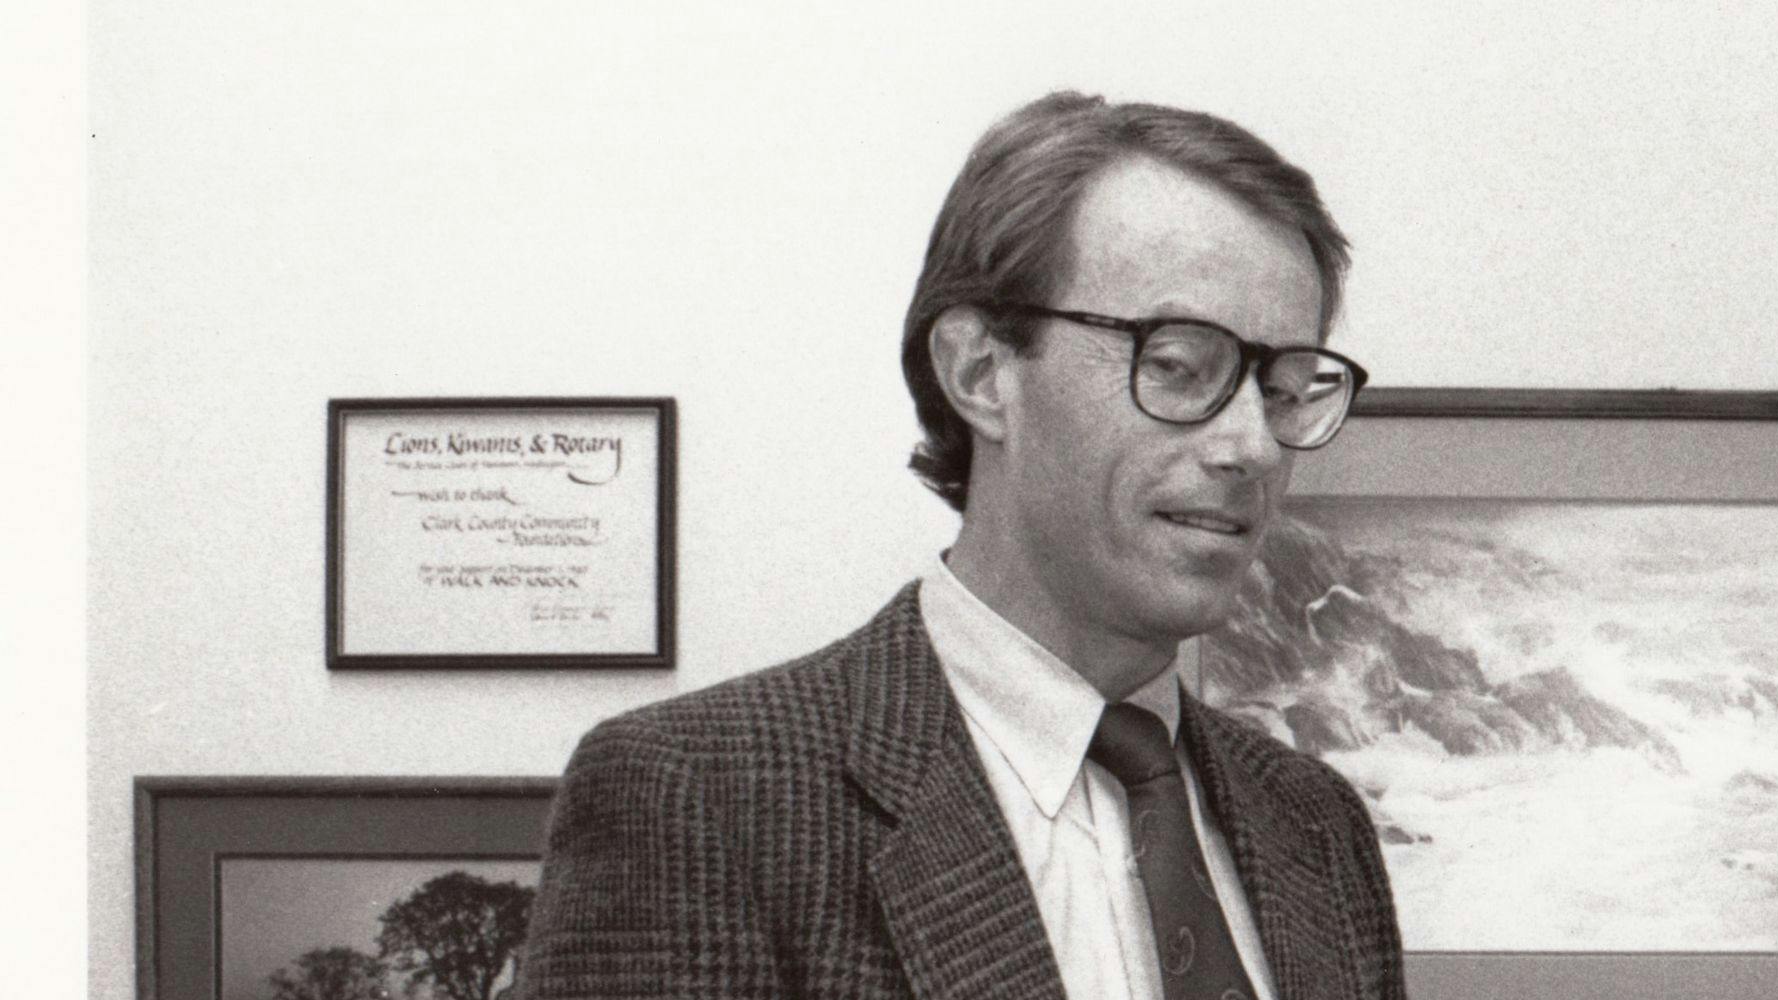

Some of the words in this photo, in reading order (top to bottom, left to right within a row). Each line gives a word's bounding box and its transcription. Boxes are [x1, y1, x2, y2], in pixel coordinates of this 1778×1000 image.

[384, 432, 442, 455] Lions,
[447, 432, 525, 457] Kiwanis,
[529, 433, 547, 454] &
[453, 489, 467, 501] to
[470, 486, 516, 505] thank
[421, 515, 464, 532] Clark
[468, 514, 517, 532] County
[519, 513, 600, 534] Community
[440, 577, 483, 587] WALK
[490, 576, 522, 587] AND
[526, 577, 580, 588] KNOCK
